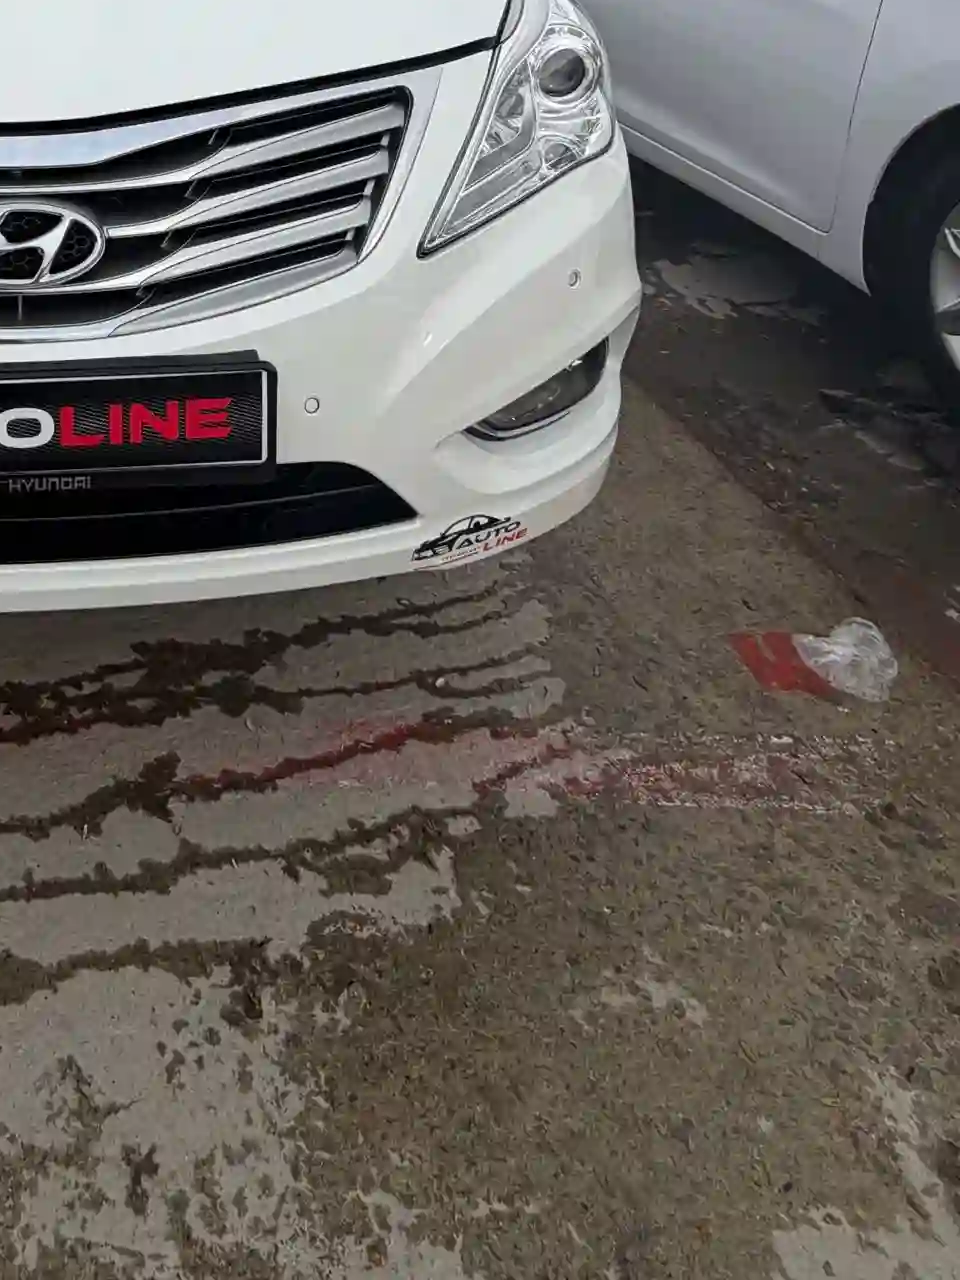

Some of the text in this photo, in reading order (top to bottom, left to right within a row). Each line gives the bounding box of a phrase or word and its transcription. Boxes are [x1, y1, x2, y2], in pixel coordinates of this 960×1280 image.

[8, 475, 92, 493] HYUNDAI
[456, 521, 521, 550] AUTO
[483, 528, 528, 552] LINE
